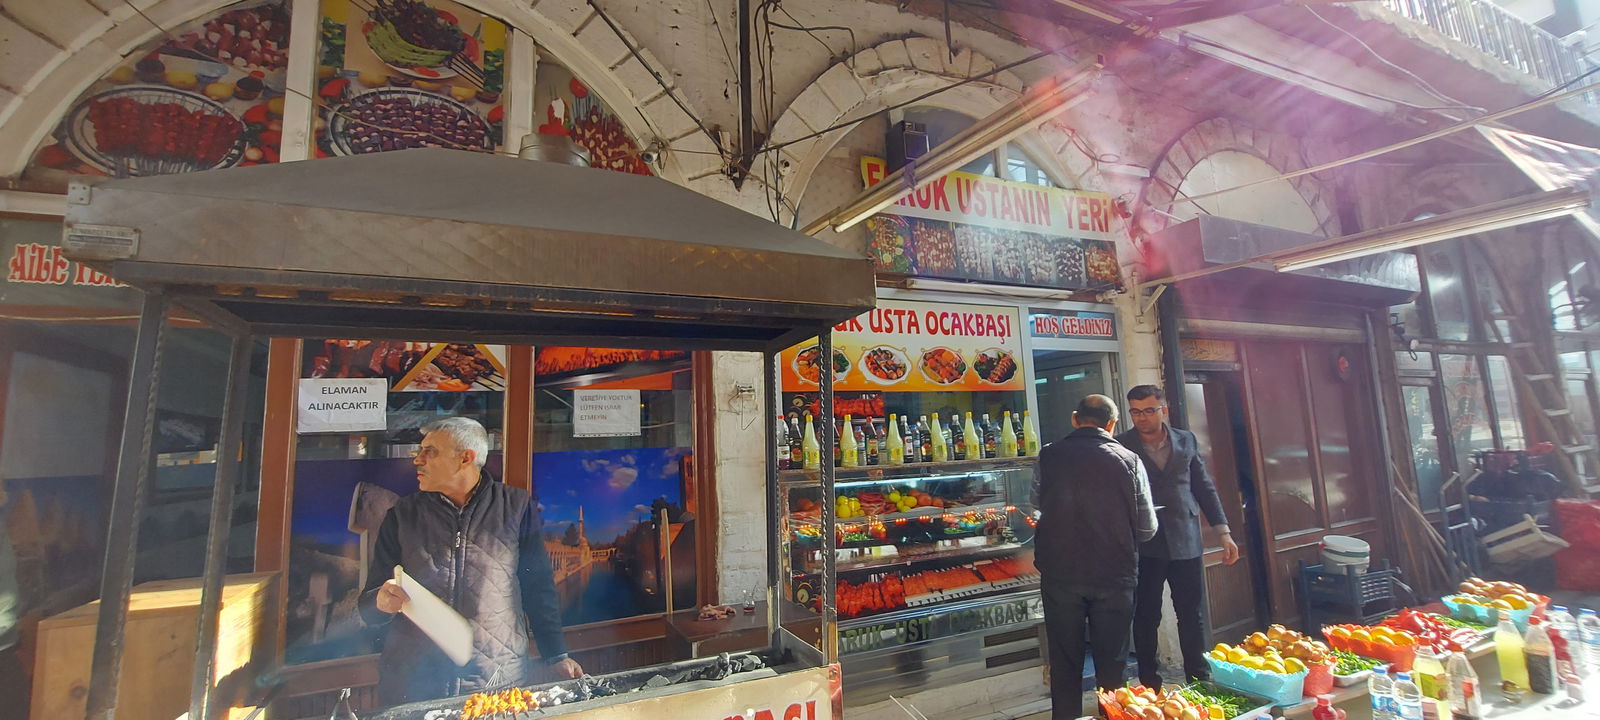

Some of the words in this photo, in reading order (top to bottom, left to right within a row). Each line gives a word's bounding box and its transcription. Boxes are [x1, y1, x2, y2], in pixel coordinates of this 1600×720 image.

[956, 177, 1051, 227] USTANIN
[868, 307, 920, 335] USTA
[925, 310, 1012, 344] OCAKBAŞI
[1034, 316, 1060, 338] HOŞ
[321, 386, 368, 395] ELAMAN
[308, 402, 379, 411] ALINACAKTIR
